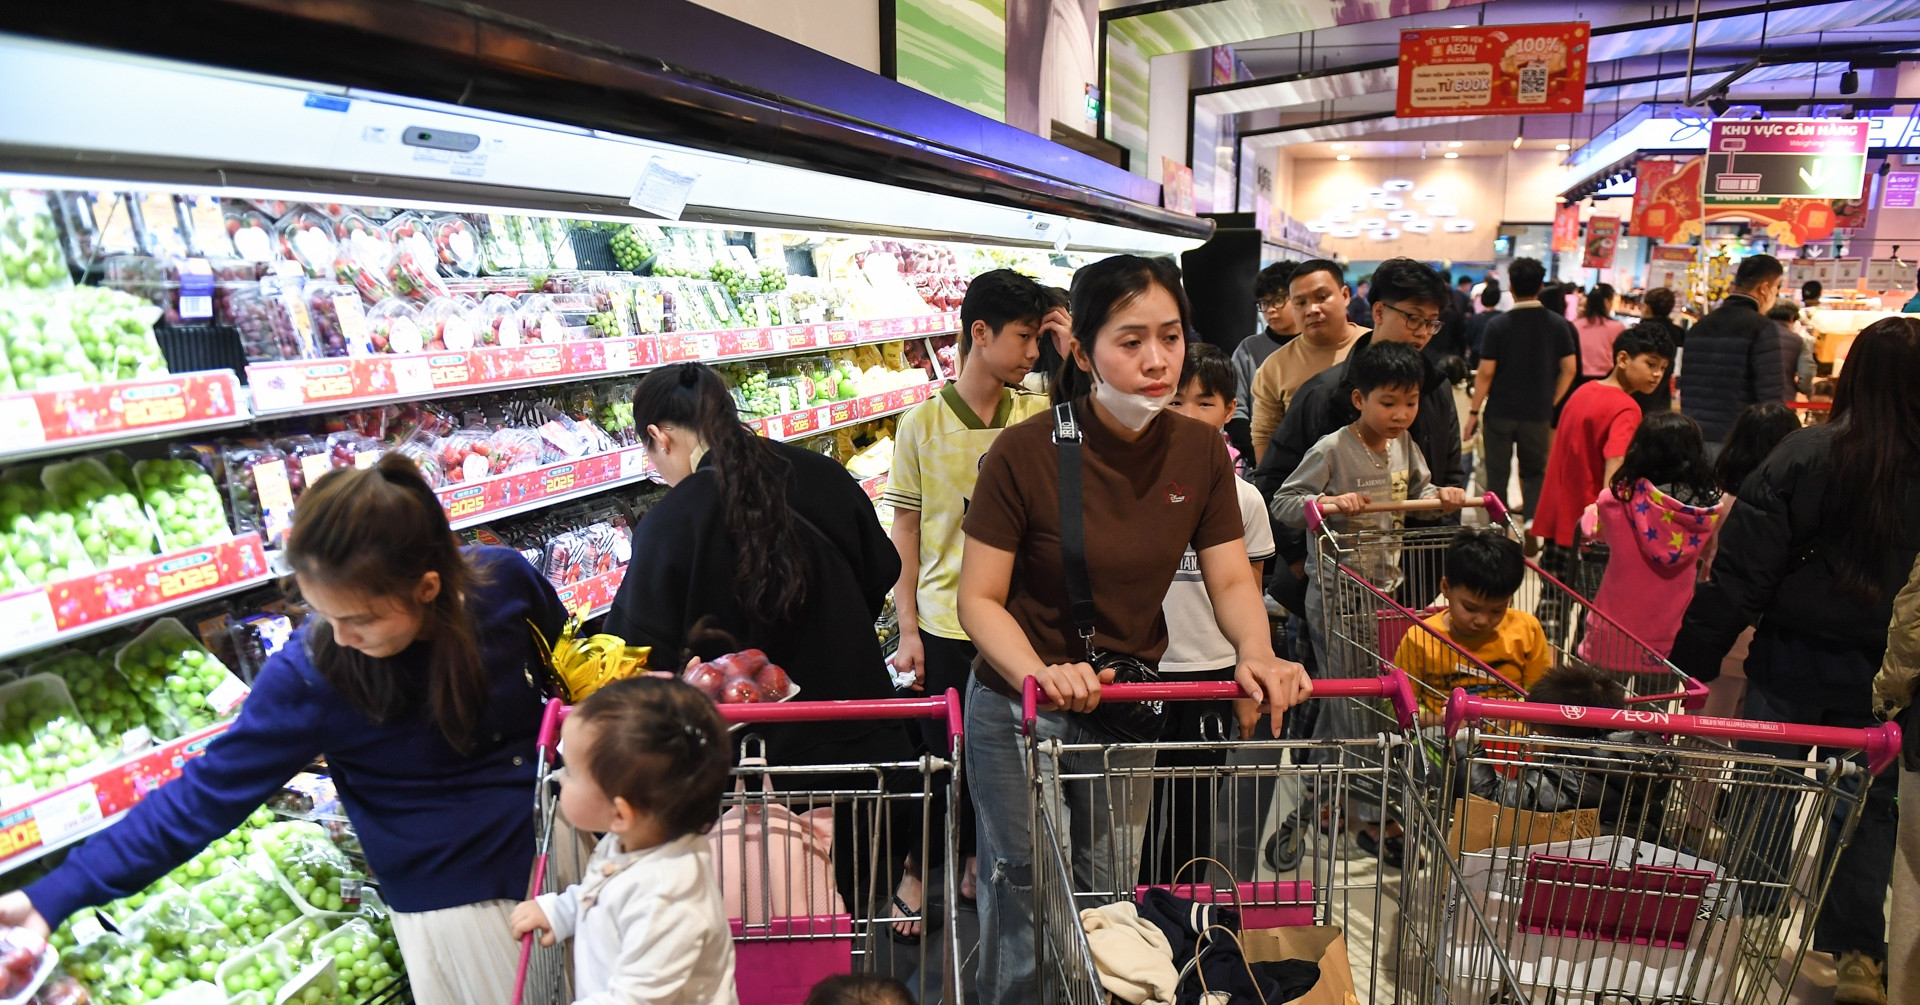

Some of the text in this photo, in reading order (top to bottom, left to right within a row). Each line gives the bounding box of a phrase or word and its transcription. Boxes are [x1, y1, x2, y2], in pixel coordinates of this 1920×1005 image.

[1446, 43, 1478, 55] AEON
[1516, 36, 1559, 53] 100%
[1438, 78, 1453, 92] TỪ
[1454, 78, 1490, 93] 600K
[1721, 123, 1858, 138] KHU VỰC CÂN HÀNG
[430, 365, 469, 385] 2025
[306, 375, 354, 398] 2025
[124, 397, 187, 426] 2025
[835, 409, 849, 422] 2025
[793, 418, 810, 432] 2025
[546, 473, 575, 493] 2025
[450, 495, 485, 518] 2025
[160, 563, 219, 597] 2025
[1611, 709, 1669, 725] AEON
[1700, 718, 1713, 726] CHILD
[1726, 720, 1746, 729] ALLOWED
[1745, 722, 1760, 730] INSIDE
[1759, 723, 1779, 731] TROLLEY
[0, 819, 42, 858] 202
